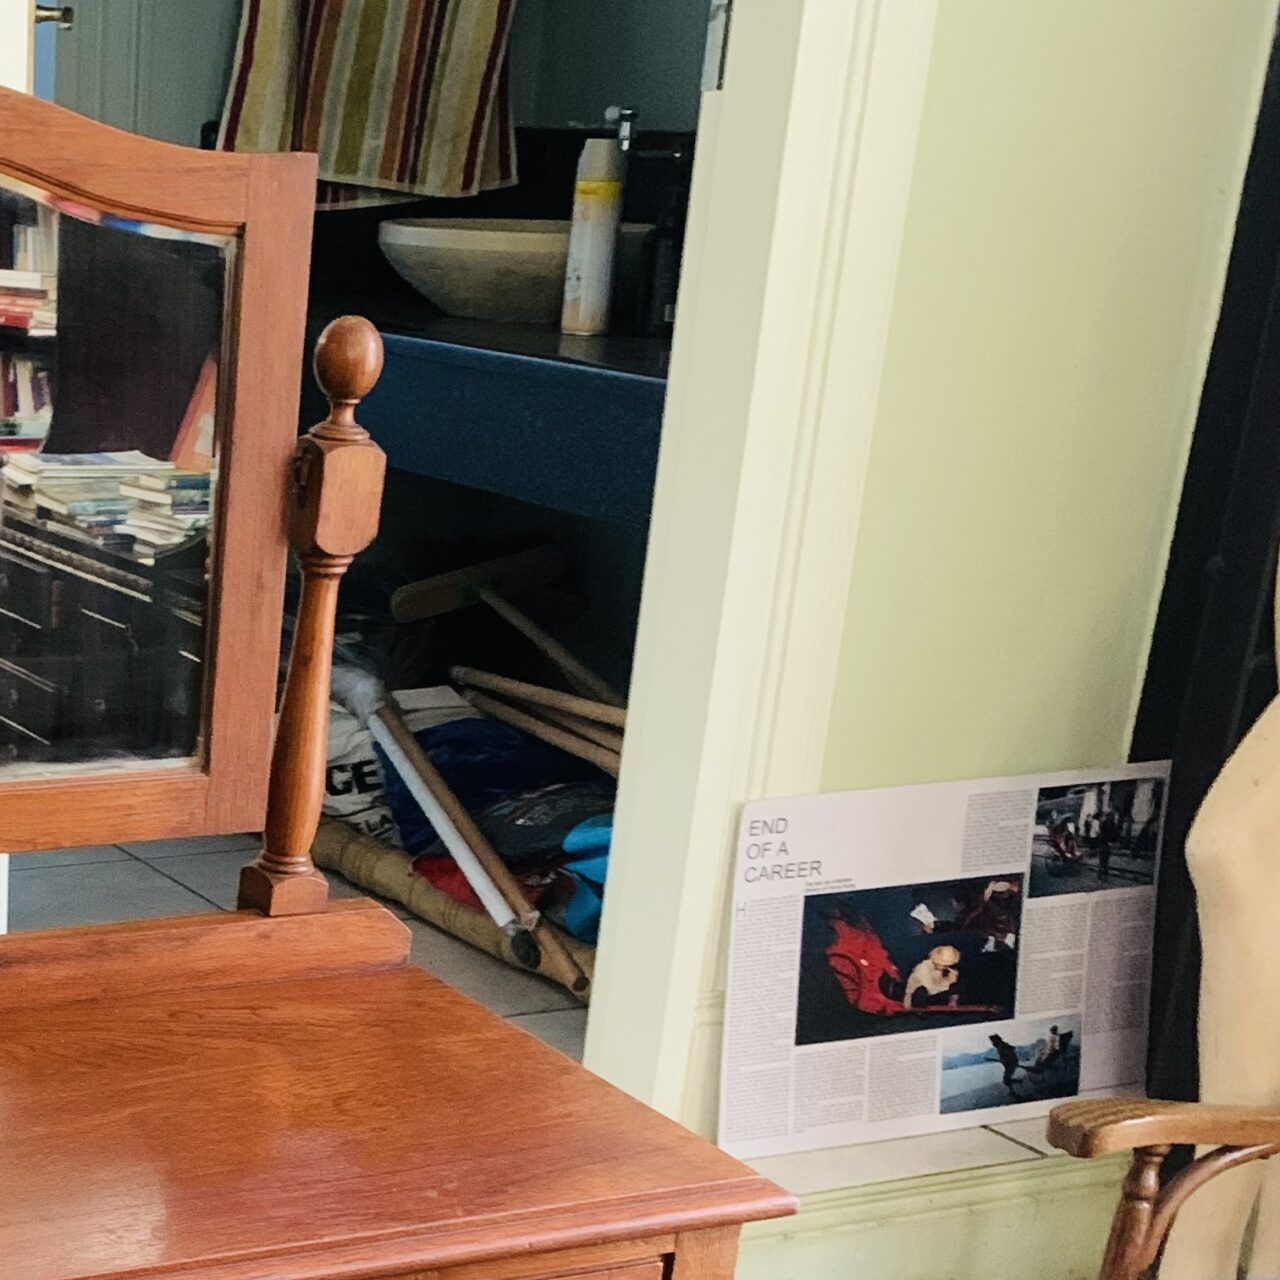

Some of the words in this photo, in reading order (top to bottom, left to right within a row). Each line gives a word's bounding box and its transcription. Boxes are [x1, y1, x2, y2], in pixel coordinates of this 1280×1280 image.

[749, 817, 789, 837] END
[746, 842, 773, 860] OF
[776, 841, 789, 857] A
[744, 860, 822, 883] CAREER
